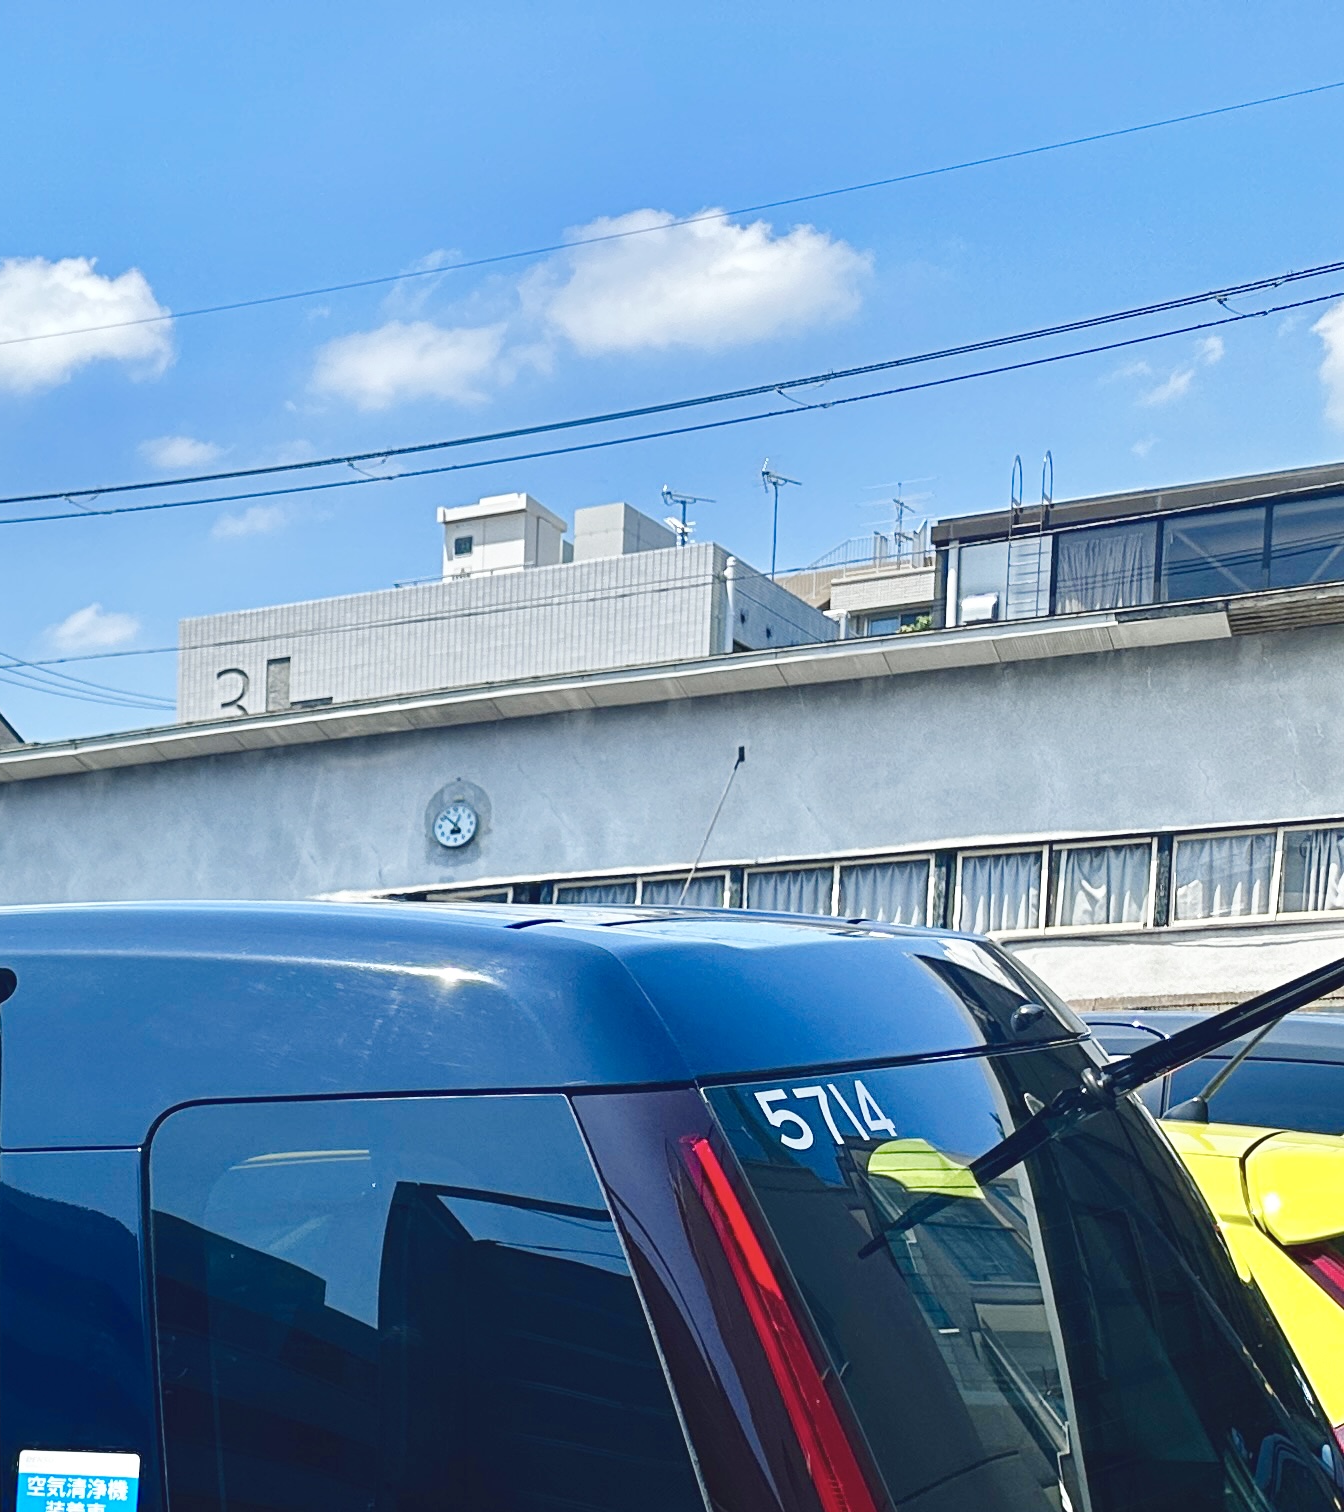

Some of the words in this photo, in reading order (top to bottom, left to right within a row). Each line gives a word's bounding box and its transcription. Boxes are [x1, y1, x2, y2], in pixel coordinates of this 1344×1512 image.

[754, 1080, 898, 1150] 5714
[26, 1476, 130, 1501] 空気清浄機
